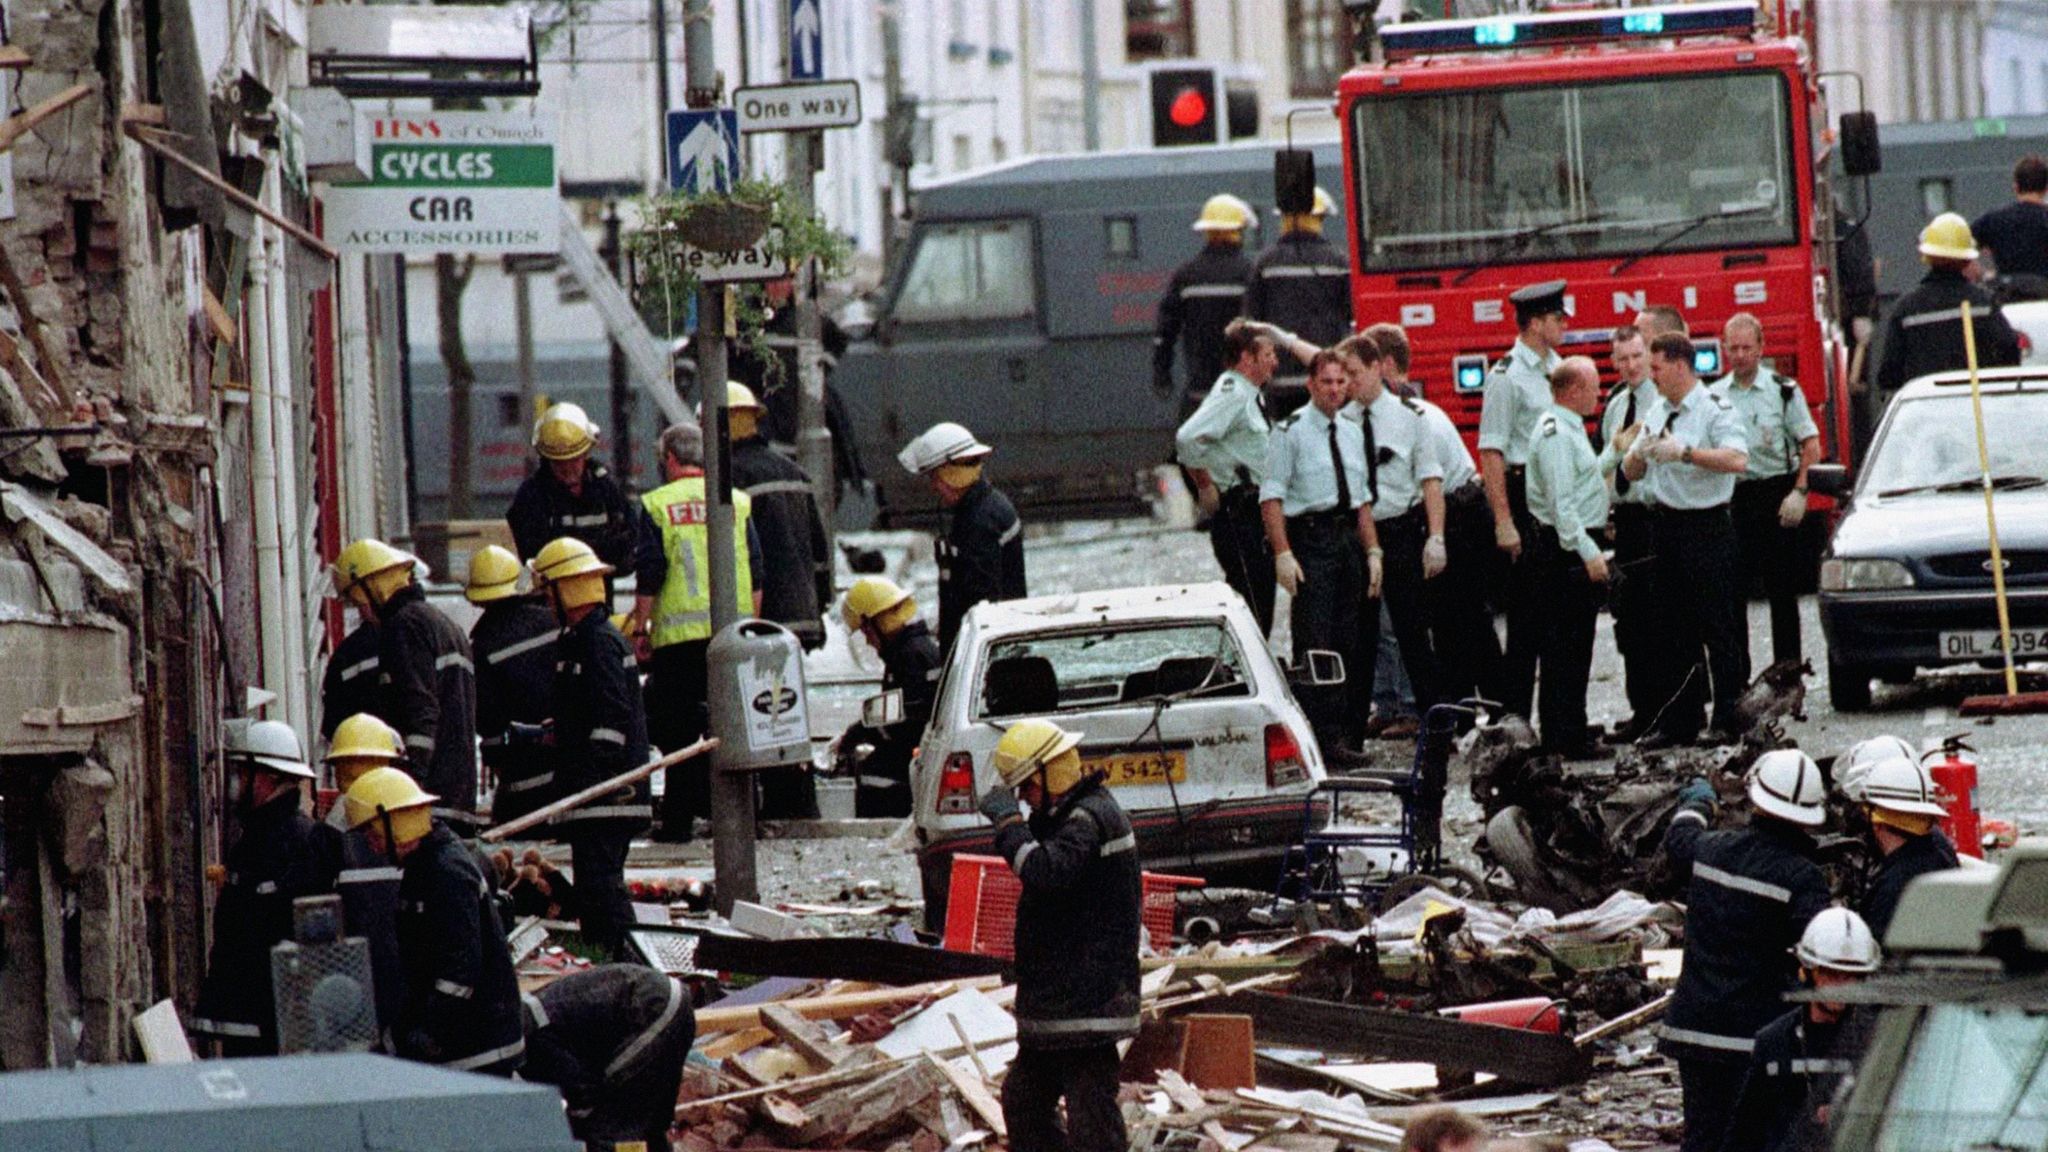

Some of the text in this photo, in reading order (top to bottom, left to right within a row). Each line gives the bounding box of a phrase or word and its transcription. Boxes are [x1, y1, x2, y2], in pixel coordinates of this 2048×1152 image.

[744, 97, 849, 119] One way
[381, 152, 495, 180] CYCLES
[409, 196, 473, 221] CAR
[346, 230, 539, 244] ACCESSORIES
[719, 245, 774, 269] way
[1948, 635, 1983, 655] OIL
